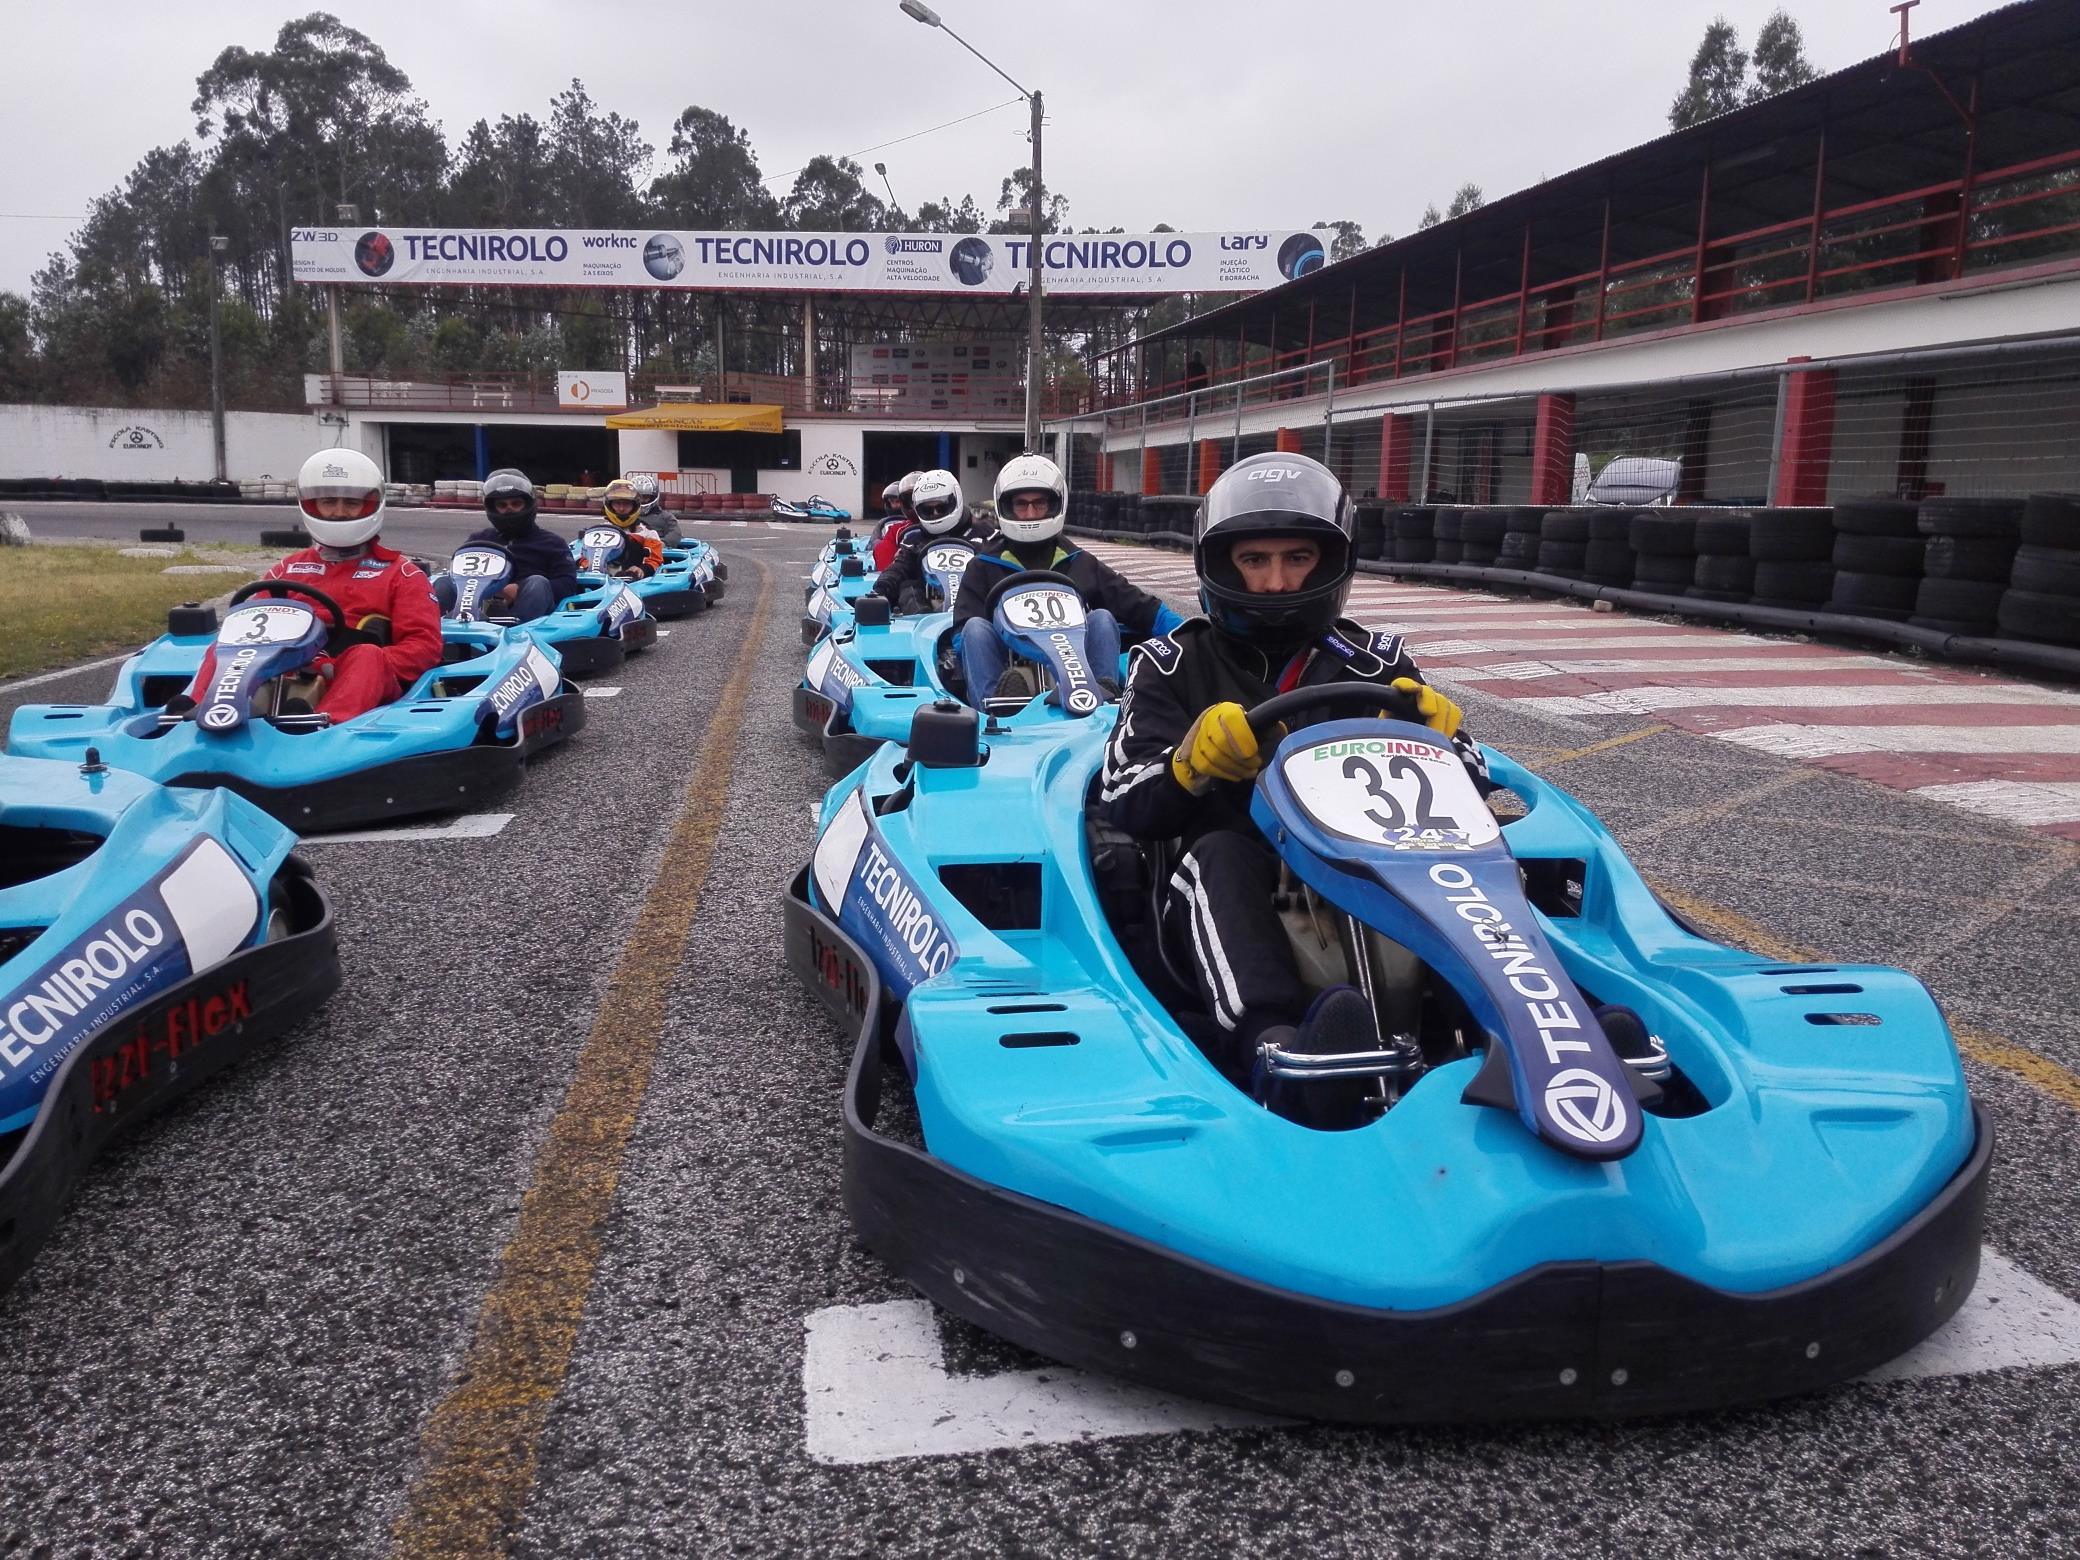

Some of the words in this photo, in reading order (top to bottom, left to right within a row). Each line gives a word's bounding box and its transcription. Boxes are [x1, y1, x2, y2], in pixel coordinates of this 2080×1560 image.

[403, 235, 568, 262] TECNIROLO
[582, 233, 637, 249] worknc
[904, 240, 939, 251] HURON
[695, 237, 870, 266] TECNIROLO
[583, 262, 622, 270] MAQUINAÇÃO
[1220, 259, 1248, 267] INJEÇÃO
[718, 271, 770, 279] ENGENHARIA
[1041, 276, 1084, 284] GENHARIA
[1248, 469, 1301, 482] agv
[593, 533, 616, 545] 27
[463, 556, 490, 573] 31
[937, 552, 966, 568] 26
[1014, 591, 1070, 601] EUROINDY
[1024, 596, 1066, 624] 30
[246, 612, 269, 640] 3
[1314, 741, 1445, 761] EUROINDY
[1342, 755, 1461, 830] 32
[1393, 827, 1444, 841] 24
[857, 896, 884, 935] ENGENHARIA
[861, 842, 949, 979] TECNIROLO
[1429, 863, 1592, 1064] TECNIROLO
[0, 909, 163, 1081] ECNIROLO
[30, 1027, 90, 1085] ENGENHARIA
